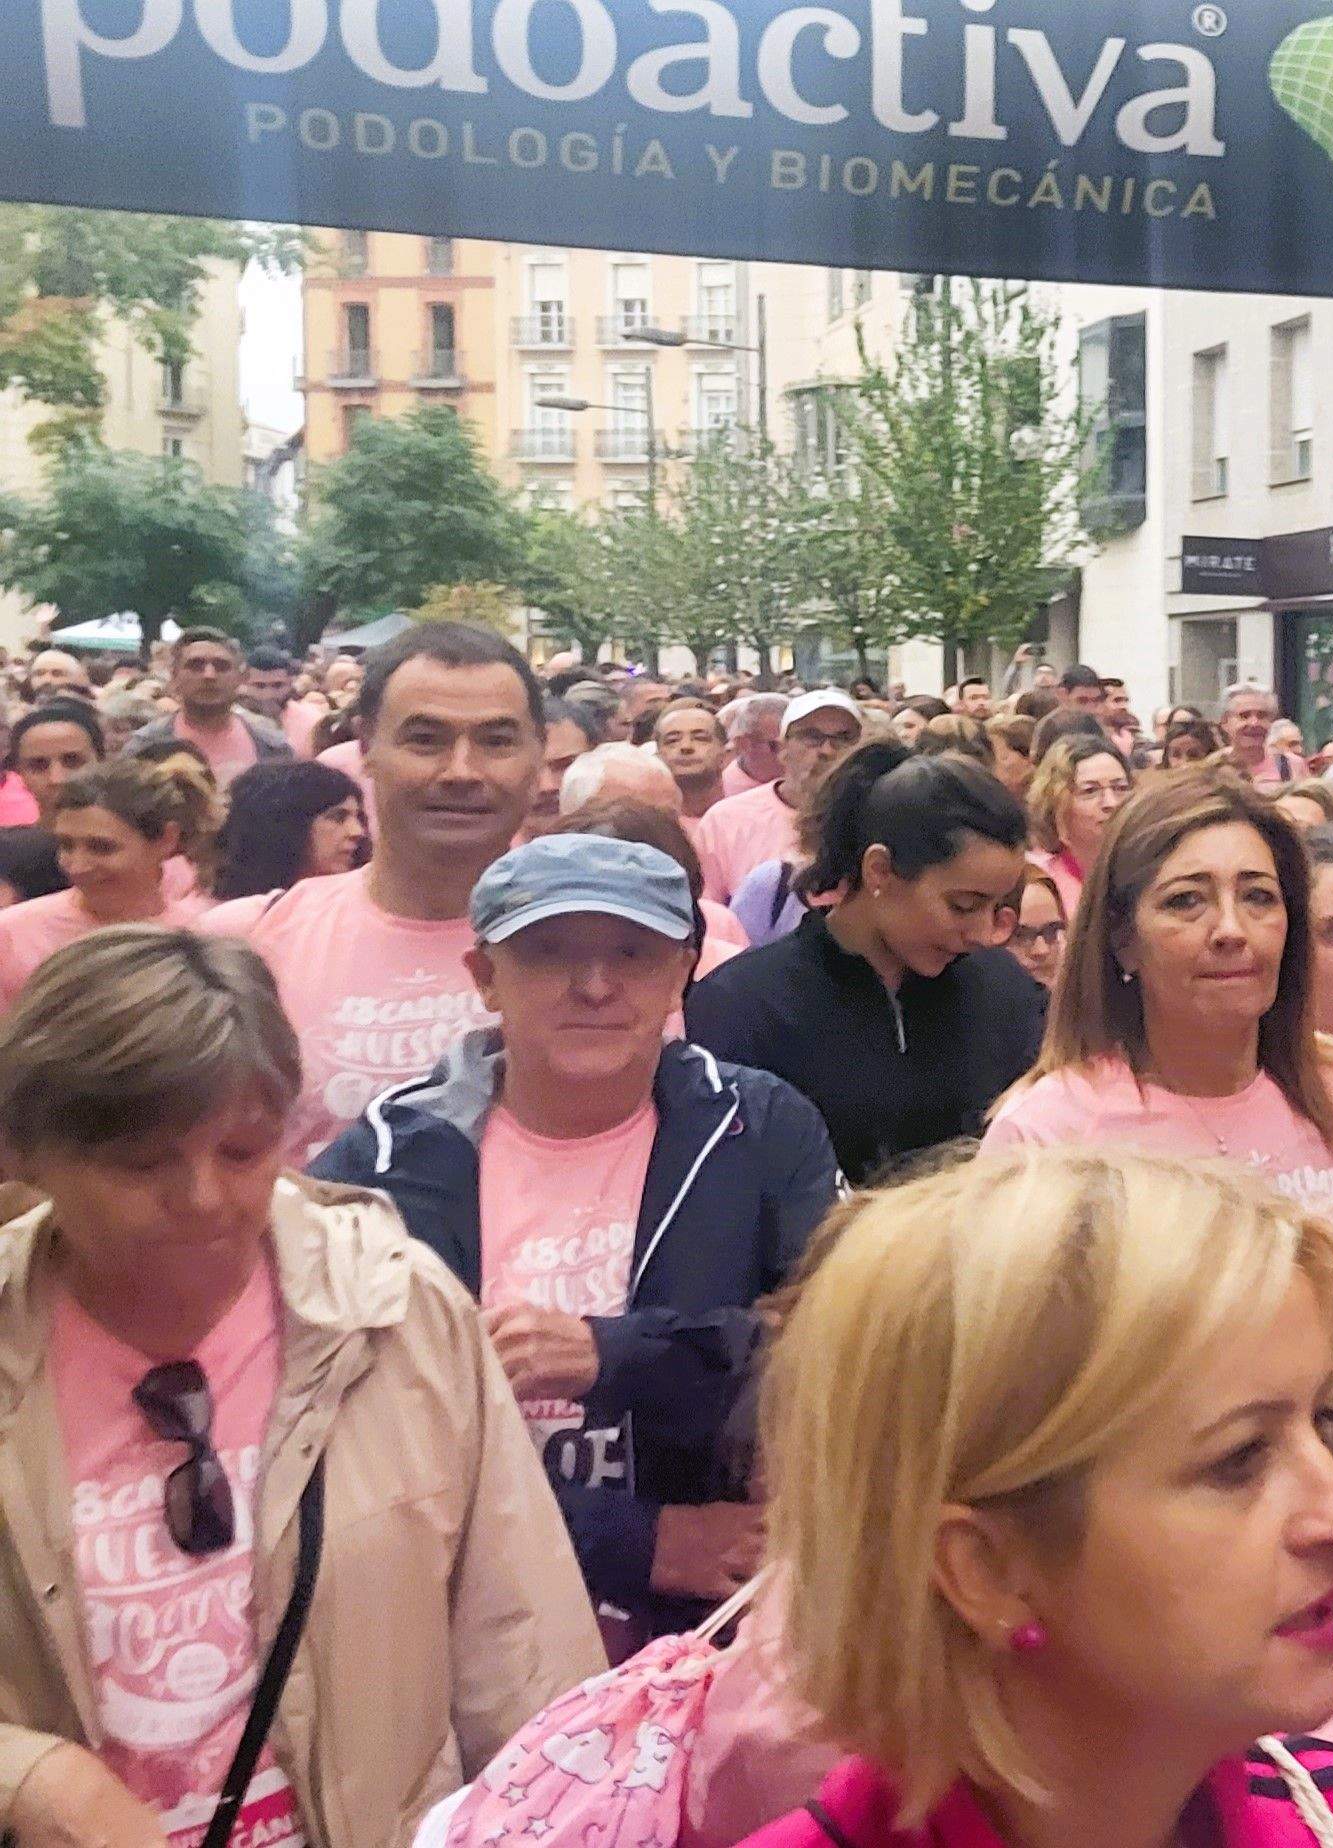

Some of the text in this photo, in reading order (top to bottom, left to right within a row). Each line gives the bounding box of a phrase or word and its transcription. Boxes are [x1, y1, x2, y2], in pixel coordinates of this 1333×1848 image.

[248, 102, 1219, 219] PODOLOGÍA Y BIOMECÁNICA
